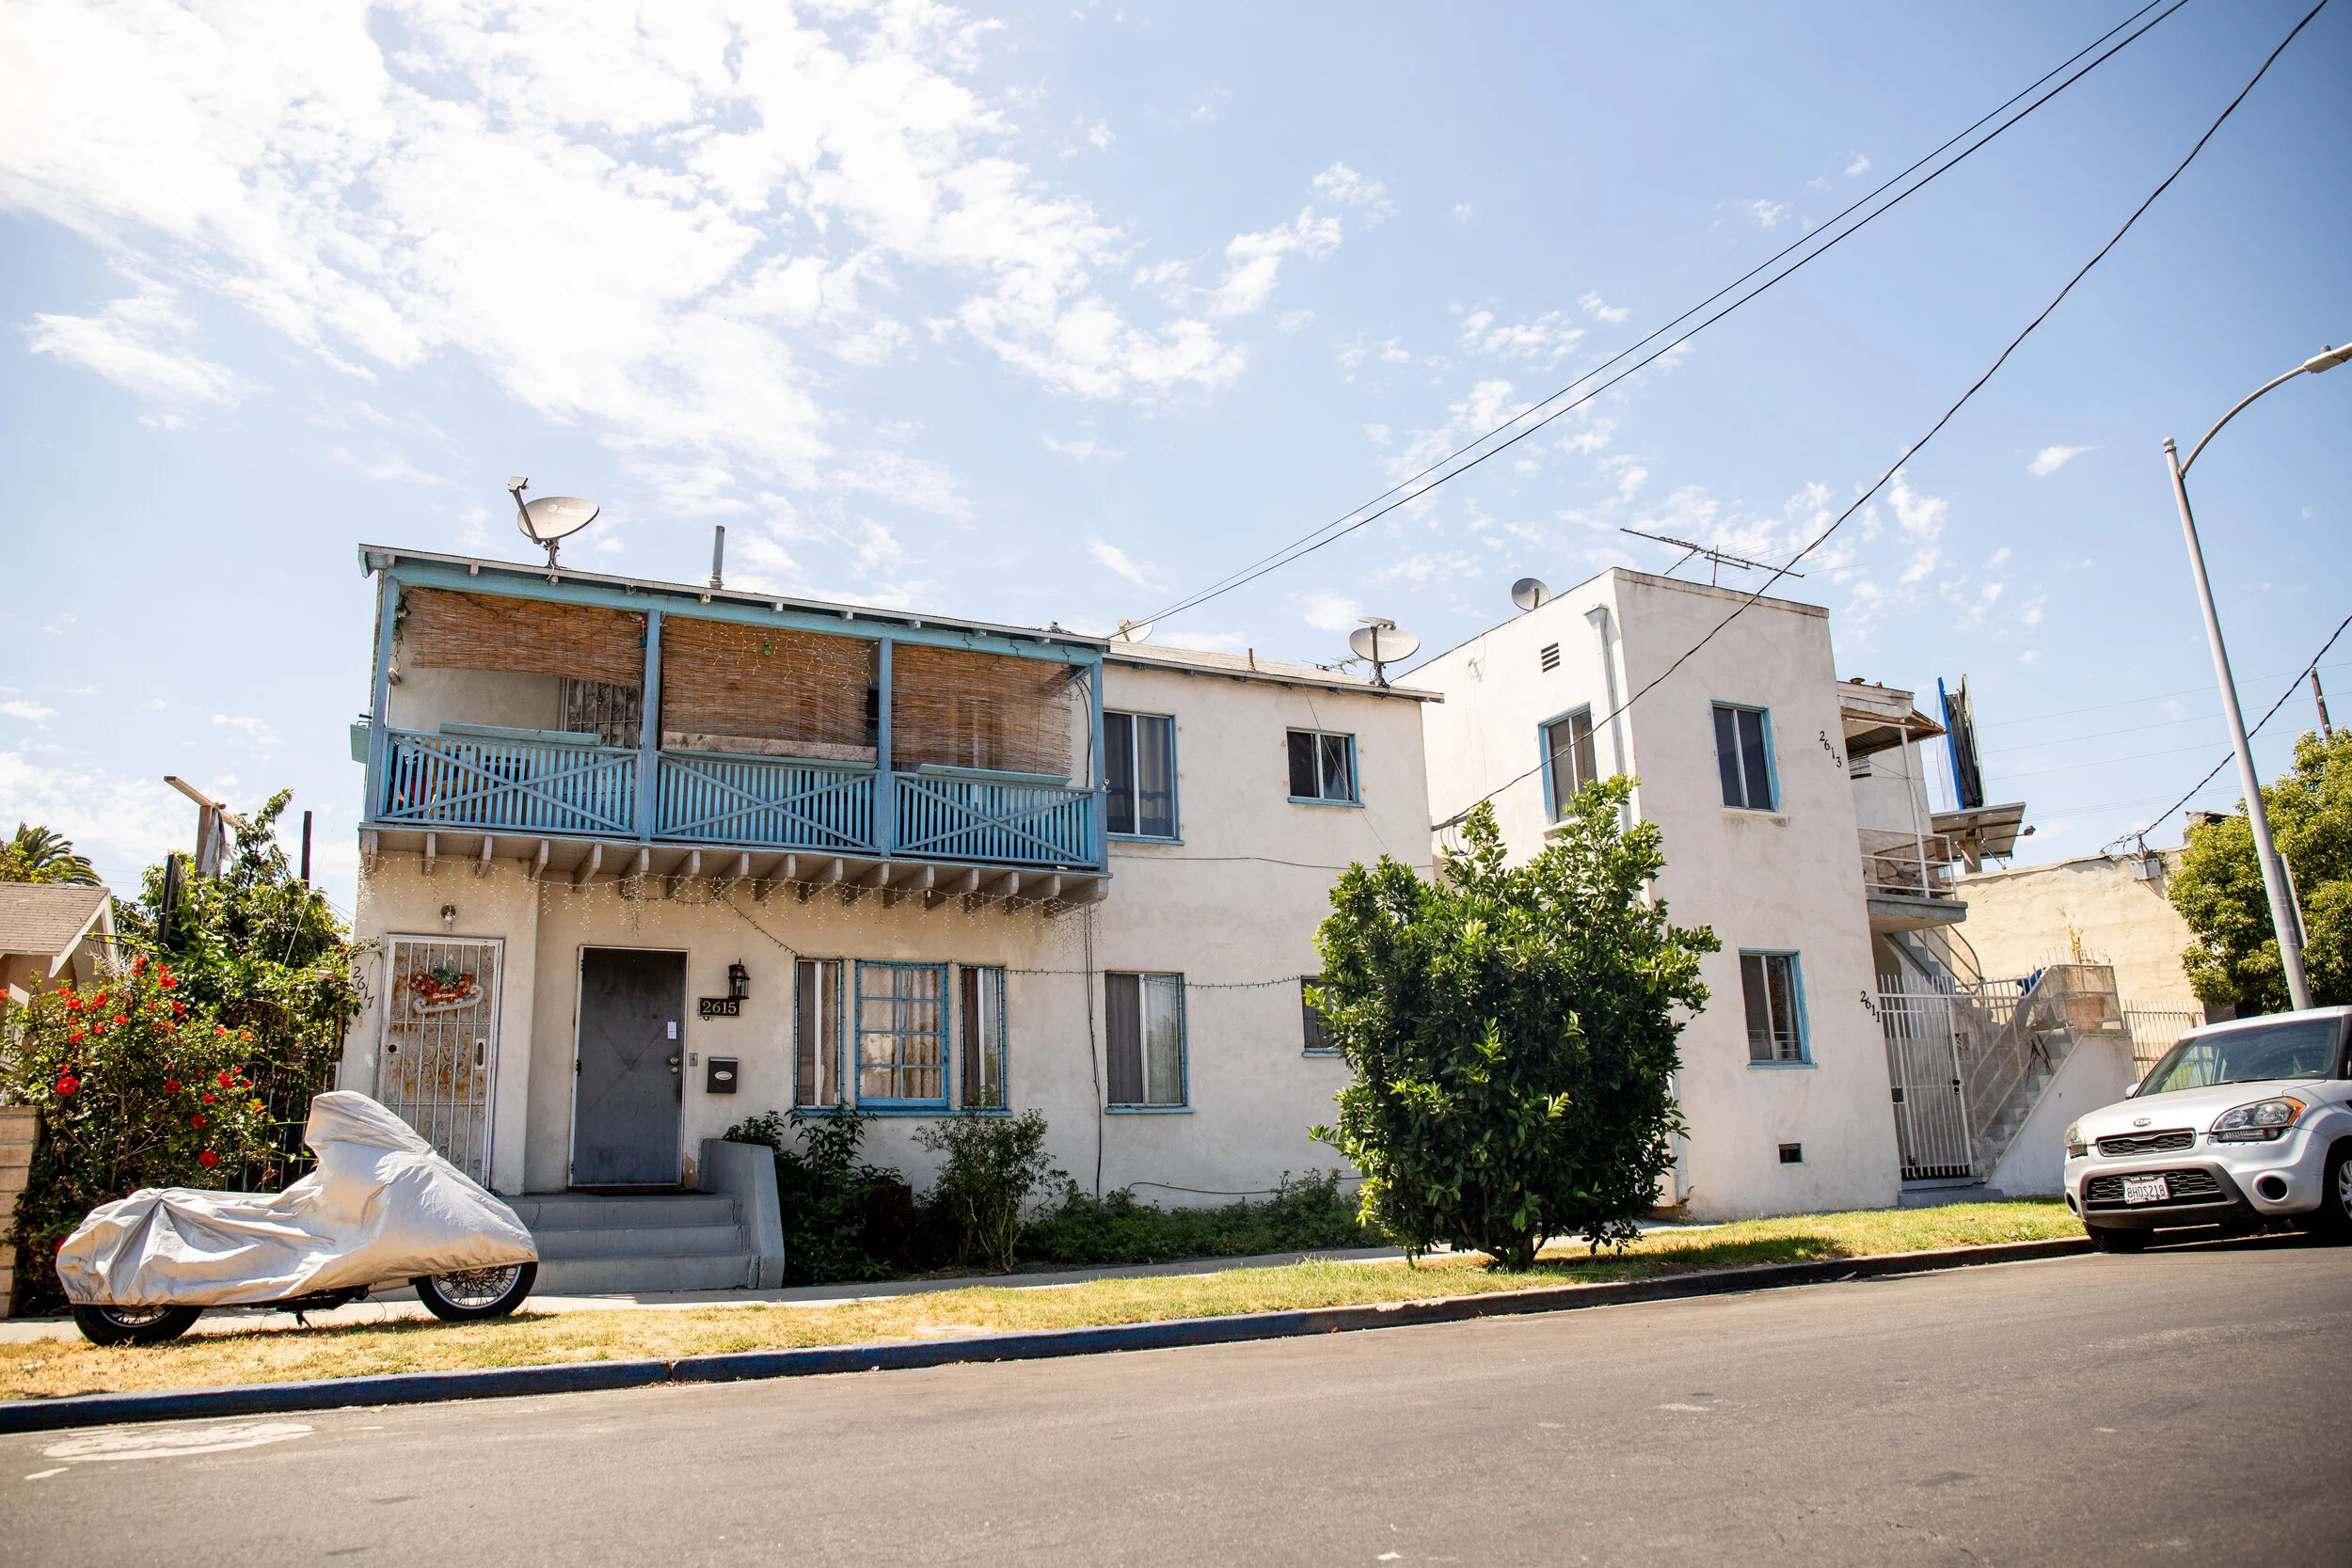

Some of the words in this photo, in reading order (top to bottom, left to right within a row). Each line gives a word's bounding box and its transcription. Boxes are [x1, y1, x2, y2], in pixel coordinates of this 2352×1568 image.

[1820, 731, 1842, 768] 2613
[353, 966, 374, 1009] 2617
[702, 1001, 737, 1014] 2615
[1860, 990, 1881, 1022] 2611
